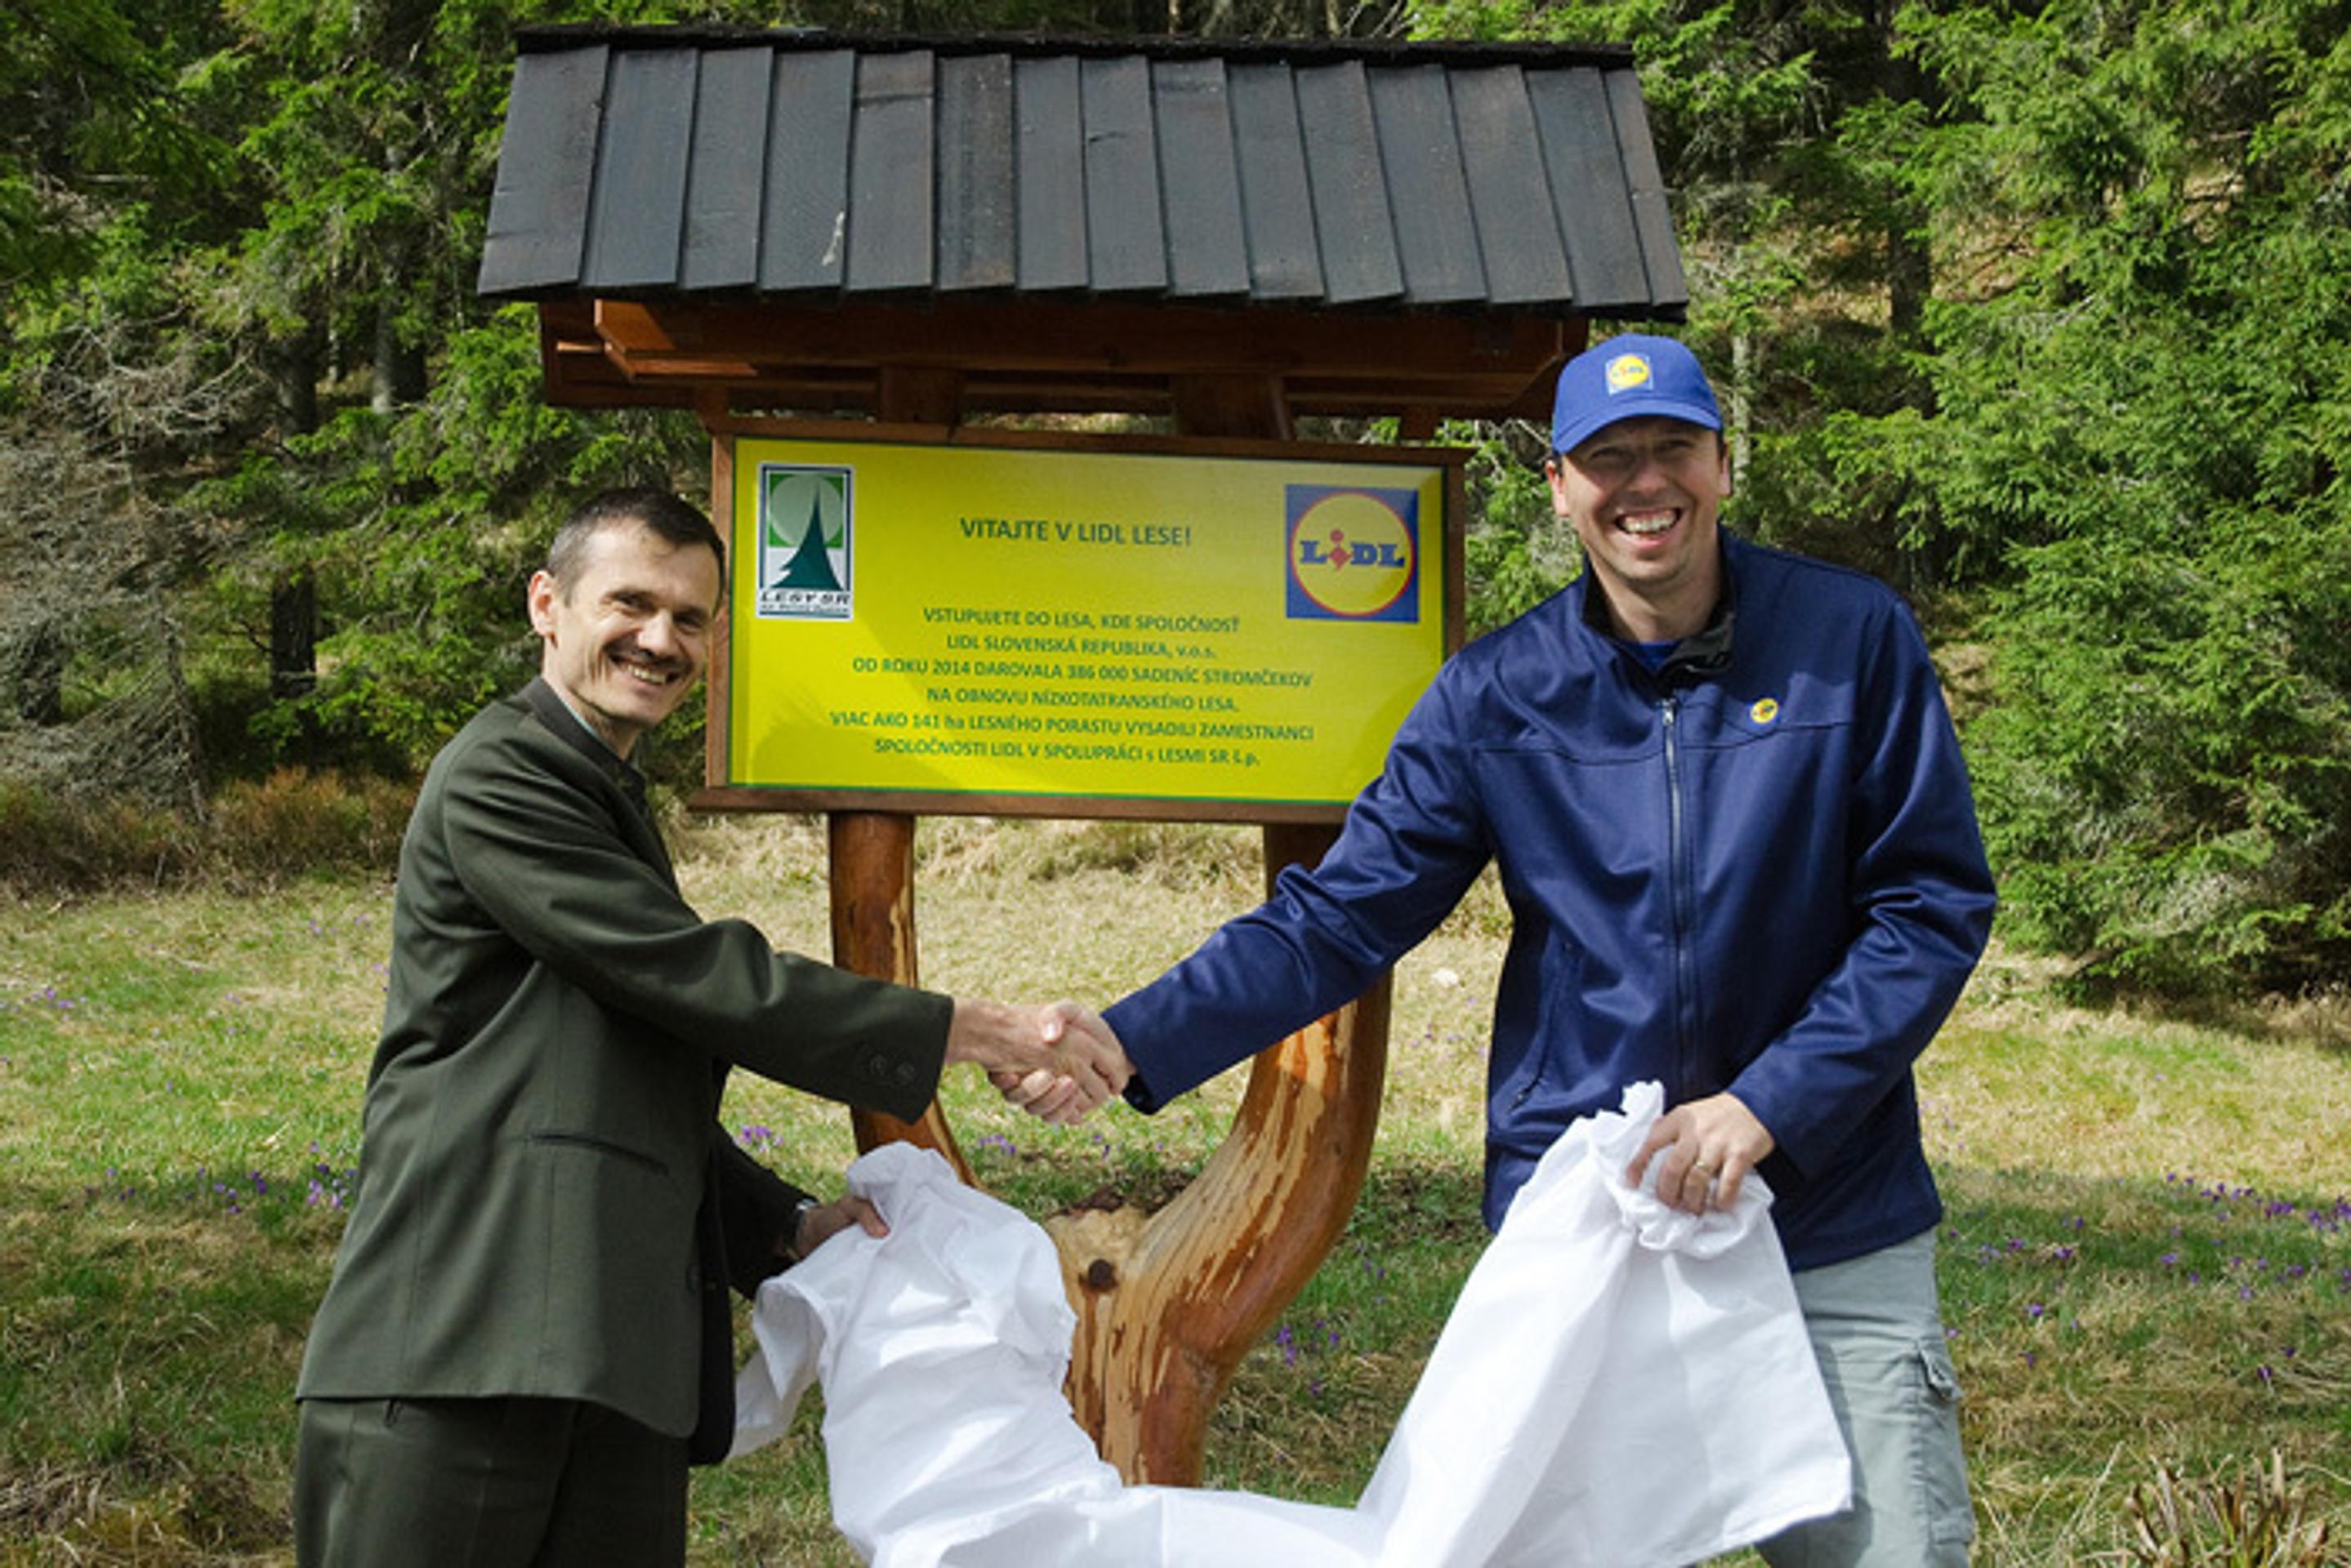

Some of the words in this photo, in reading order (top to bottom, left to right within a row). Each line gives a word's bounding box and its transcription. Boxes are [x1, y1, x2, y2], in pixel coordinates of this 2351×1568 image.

[960, 518, 1049, 541] VITAJTE
[1055, 522, 1073, 541] V
[1077, 523, 1126, 544] LIDL
[1132, 526, 1190, 545] LESE!
[923, 608, 1021, 626] VSTUPUJETE
[1024, 612, 1051, 626] DO
[1100, 615, 1131, 629] KDE
[947, 635, 980, 649] LIDL
[984, 635, 1077, 653] SLOVENSKÁ
[852, 657, 878, 672] OD
[881, 658, 929, 675] ROKU
[932, 659, 971, 675] 2014
[974, 662, 1064, 679] DAROVALA
[1098, 666, 1129, 681] 000
[926, 688, 952, 702] NA
[954, 688, 1028, 705] OBNOVU
[829, 712, 869, 726] VIAC
[872, 712, 908, 728] AKO
[912, 710, 940, 729] 141
[944, 713, 965, 730] ha
[968, 714, 1042, 732] LESNÉHO
[1045, 719, 1122, 735] PORASTU
[1125, 720, 1196, 737] VYSADILI
[1199, 723, 1314, 740] ZAMESTNANCI
[874, 737, 988, 755] SPOLOČNOSTI
[991, 742, 1024, 757] LIDL
[1027, 743, 1042, 757] V
[1044, 742, 1143, 761] SPOLUPRÁCI
[1158, 748, 1206, 762] LESMI
[1209, 750, 1229, 764] SR
